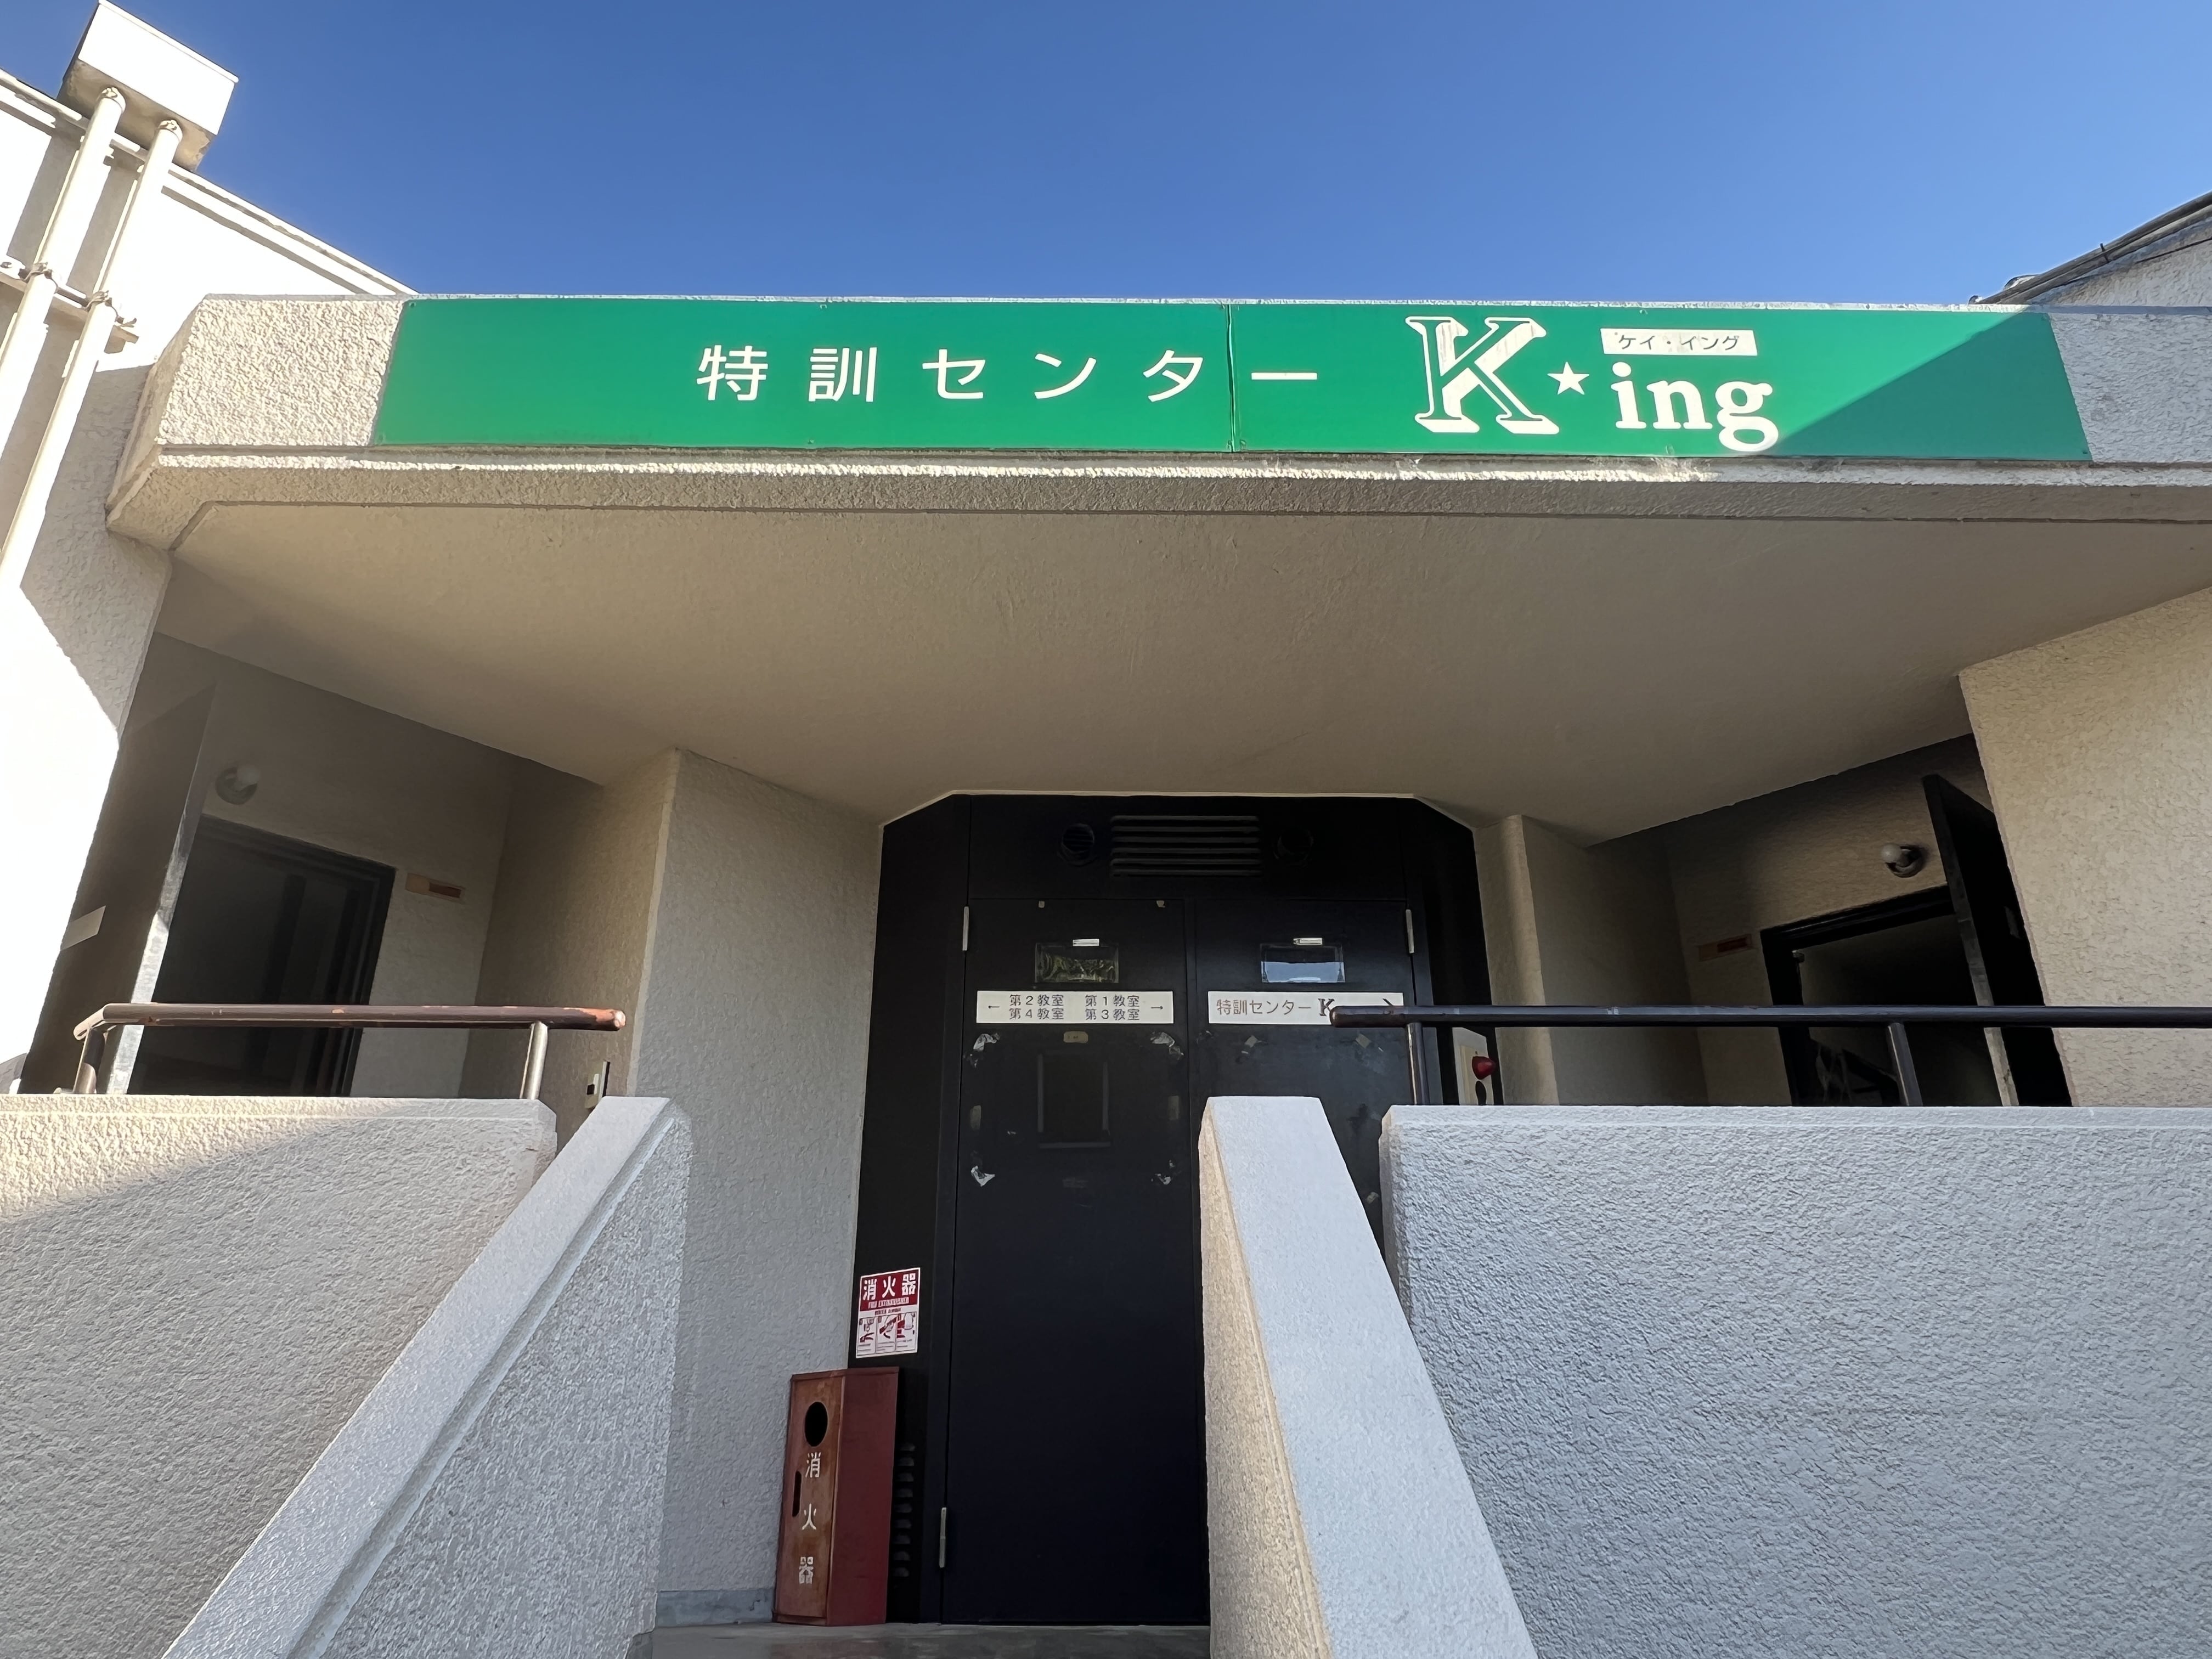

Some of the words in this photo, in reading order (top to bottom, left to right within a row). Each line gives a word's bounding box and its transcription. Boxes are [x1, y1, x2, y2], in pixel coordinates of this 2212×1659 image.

[1618, 334, 1739, 351] ケイ・イング
[696, 344, 1318, 402] 特訓センター
[1009, 994, 1064, 1007] 第2教室
[1085, 994, 1139, 1007] 第1教室
[1216, 998, 1312, 1015] 特訓センター
[1009, 1008, 1064, 1020] 第4教室
[1085, 1008, 1139, 1020] 第3教室
[862, 1272, 916, 1301] 消火器
[798, 1452, 821, 1584] 消火器
